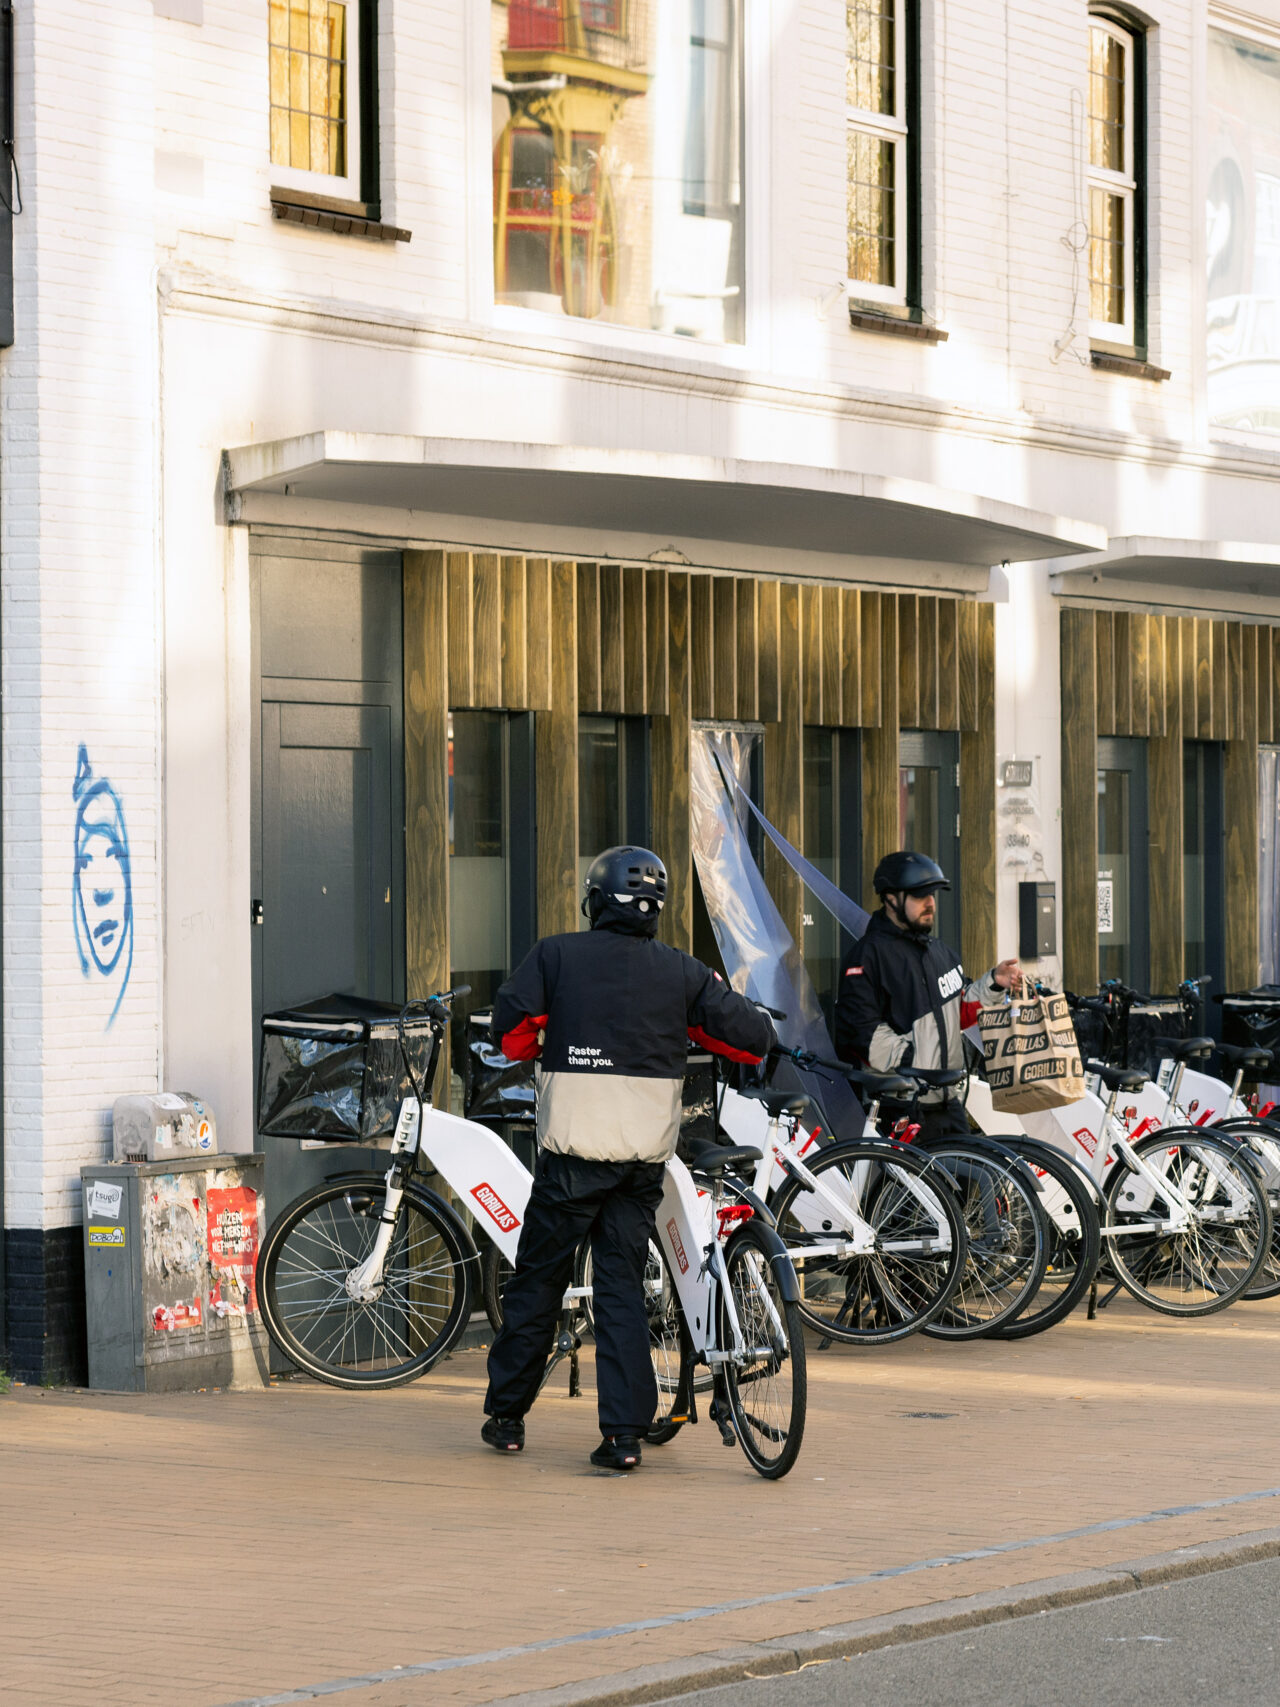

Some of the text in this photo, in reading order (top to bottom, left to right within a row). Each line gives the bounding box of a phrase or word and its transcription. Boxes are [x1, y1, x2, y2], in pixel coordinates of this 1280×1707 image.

[568, 1046, 602, 1056] Faster
[568, 1056, 614, 1068] than you.
[1023, 1060, 1065, 1081] GORILLAS
[475, 1186, 516, 1229] GORILLAS
[669, 1223, 688, 1270] GORILLAS
